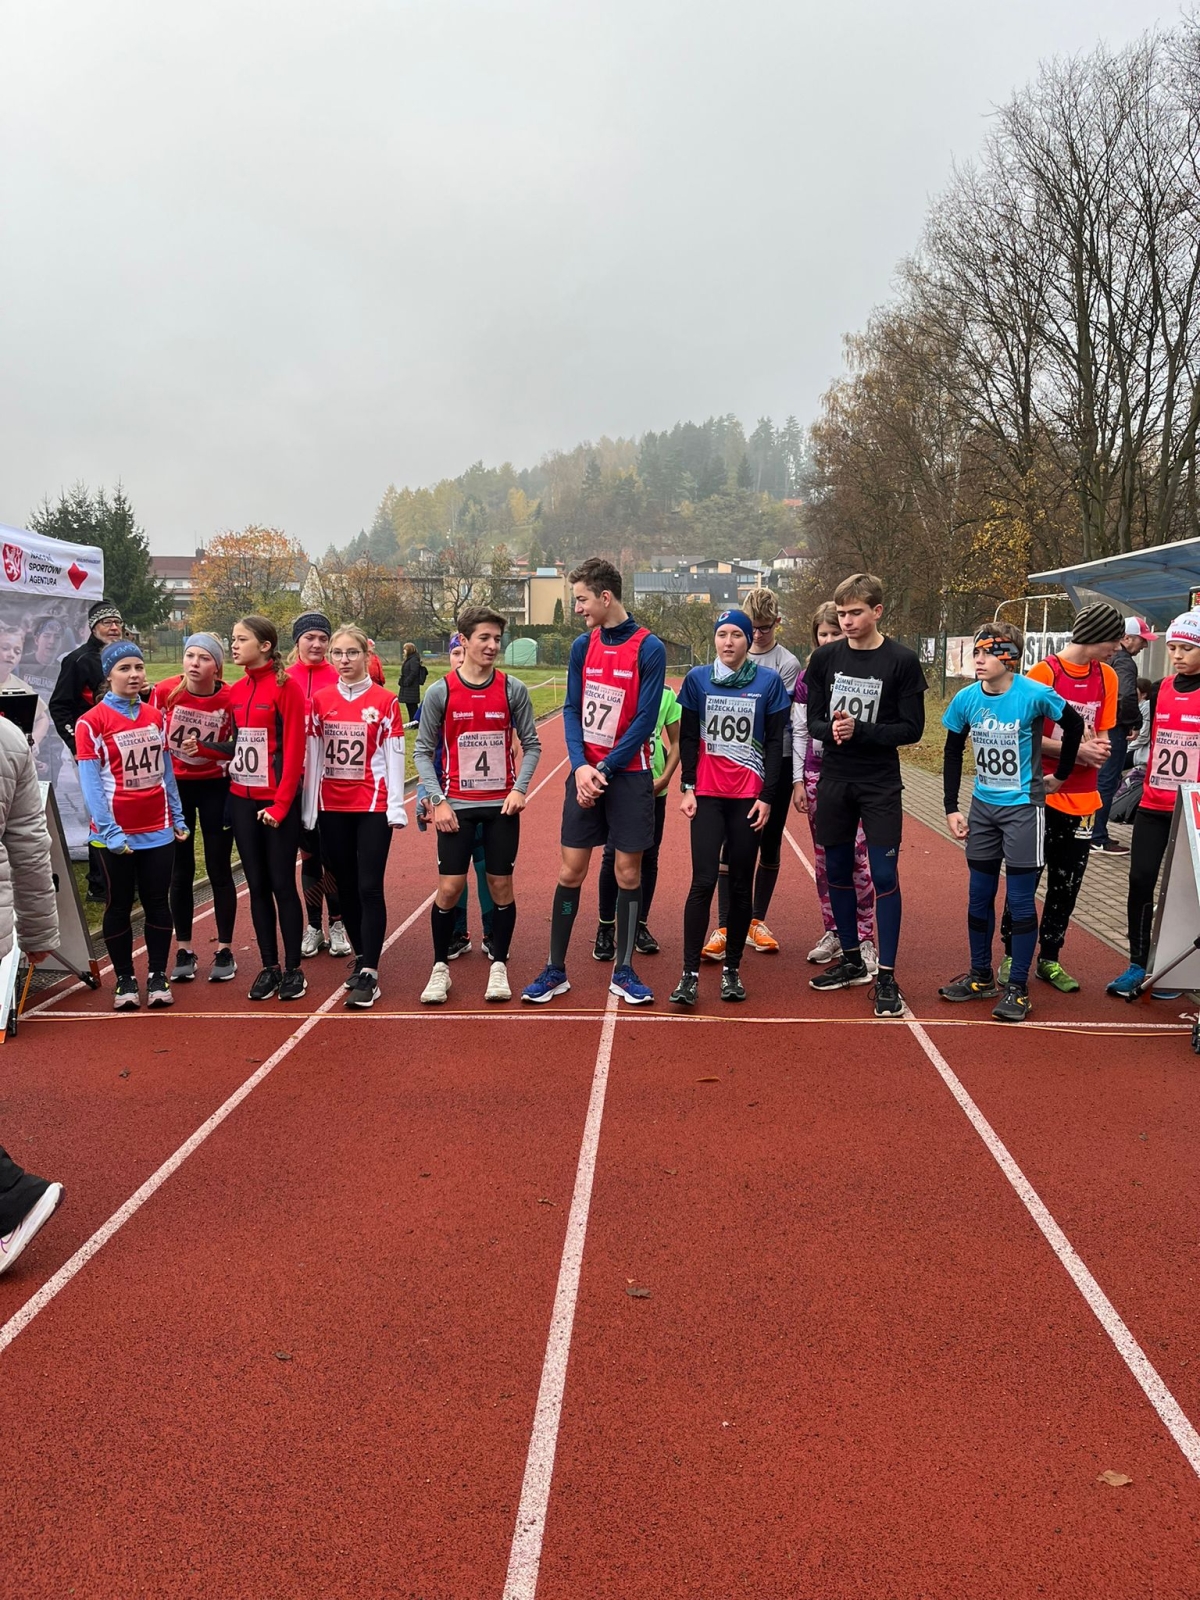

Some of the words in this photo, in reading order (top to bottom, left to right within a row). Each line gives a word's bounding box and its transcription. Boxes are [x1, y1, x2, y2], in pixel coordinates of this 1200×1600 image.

[29, 575, 57, 586] AGENTURA
[607, 695, 621, 704] LIGA
[175, 708, 195, 717] ZIMNÍ
[584, 700, 612, 730] 37
[707, 704, 735, 712] BĚŽECKÁ
[737, 706, 753, 714] LIGA
[834, 696, 875, 722] 491
[174, 714, 202, 725] BĚŽECKÁ
[983, 718, 1021, 731] Orel
[706, 715, 751, 743] 469
[117, 732, 136, 741] ZIMNÍ
[119, 737, 145, 748] BĚŽECKÁ
[972, 737, 998, 745] BĚŽECKÁ
[459, 740, 487, 748] BĚŽECKÁ
[325, 739, 365, 765] 452
[125, 744, 161, 777] 447
[234, 746, 259, 773] 30
[475, 751, 490, 776] 4
[976, 747, 1018, 776] 488
[1156, 748, 1188, 777] 20
